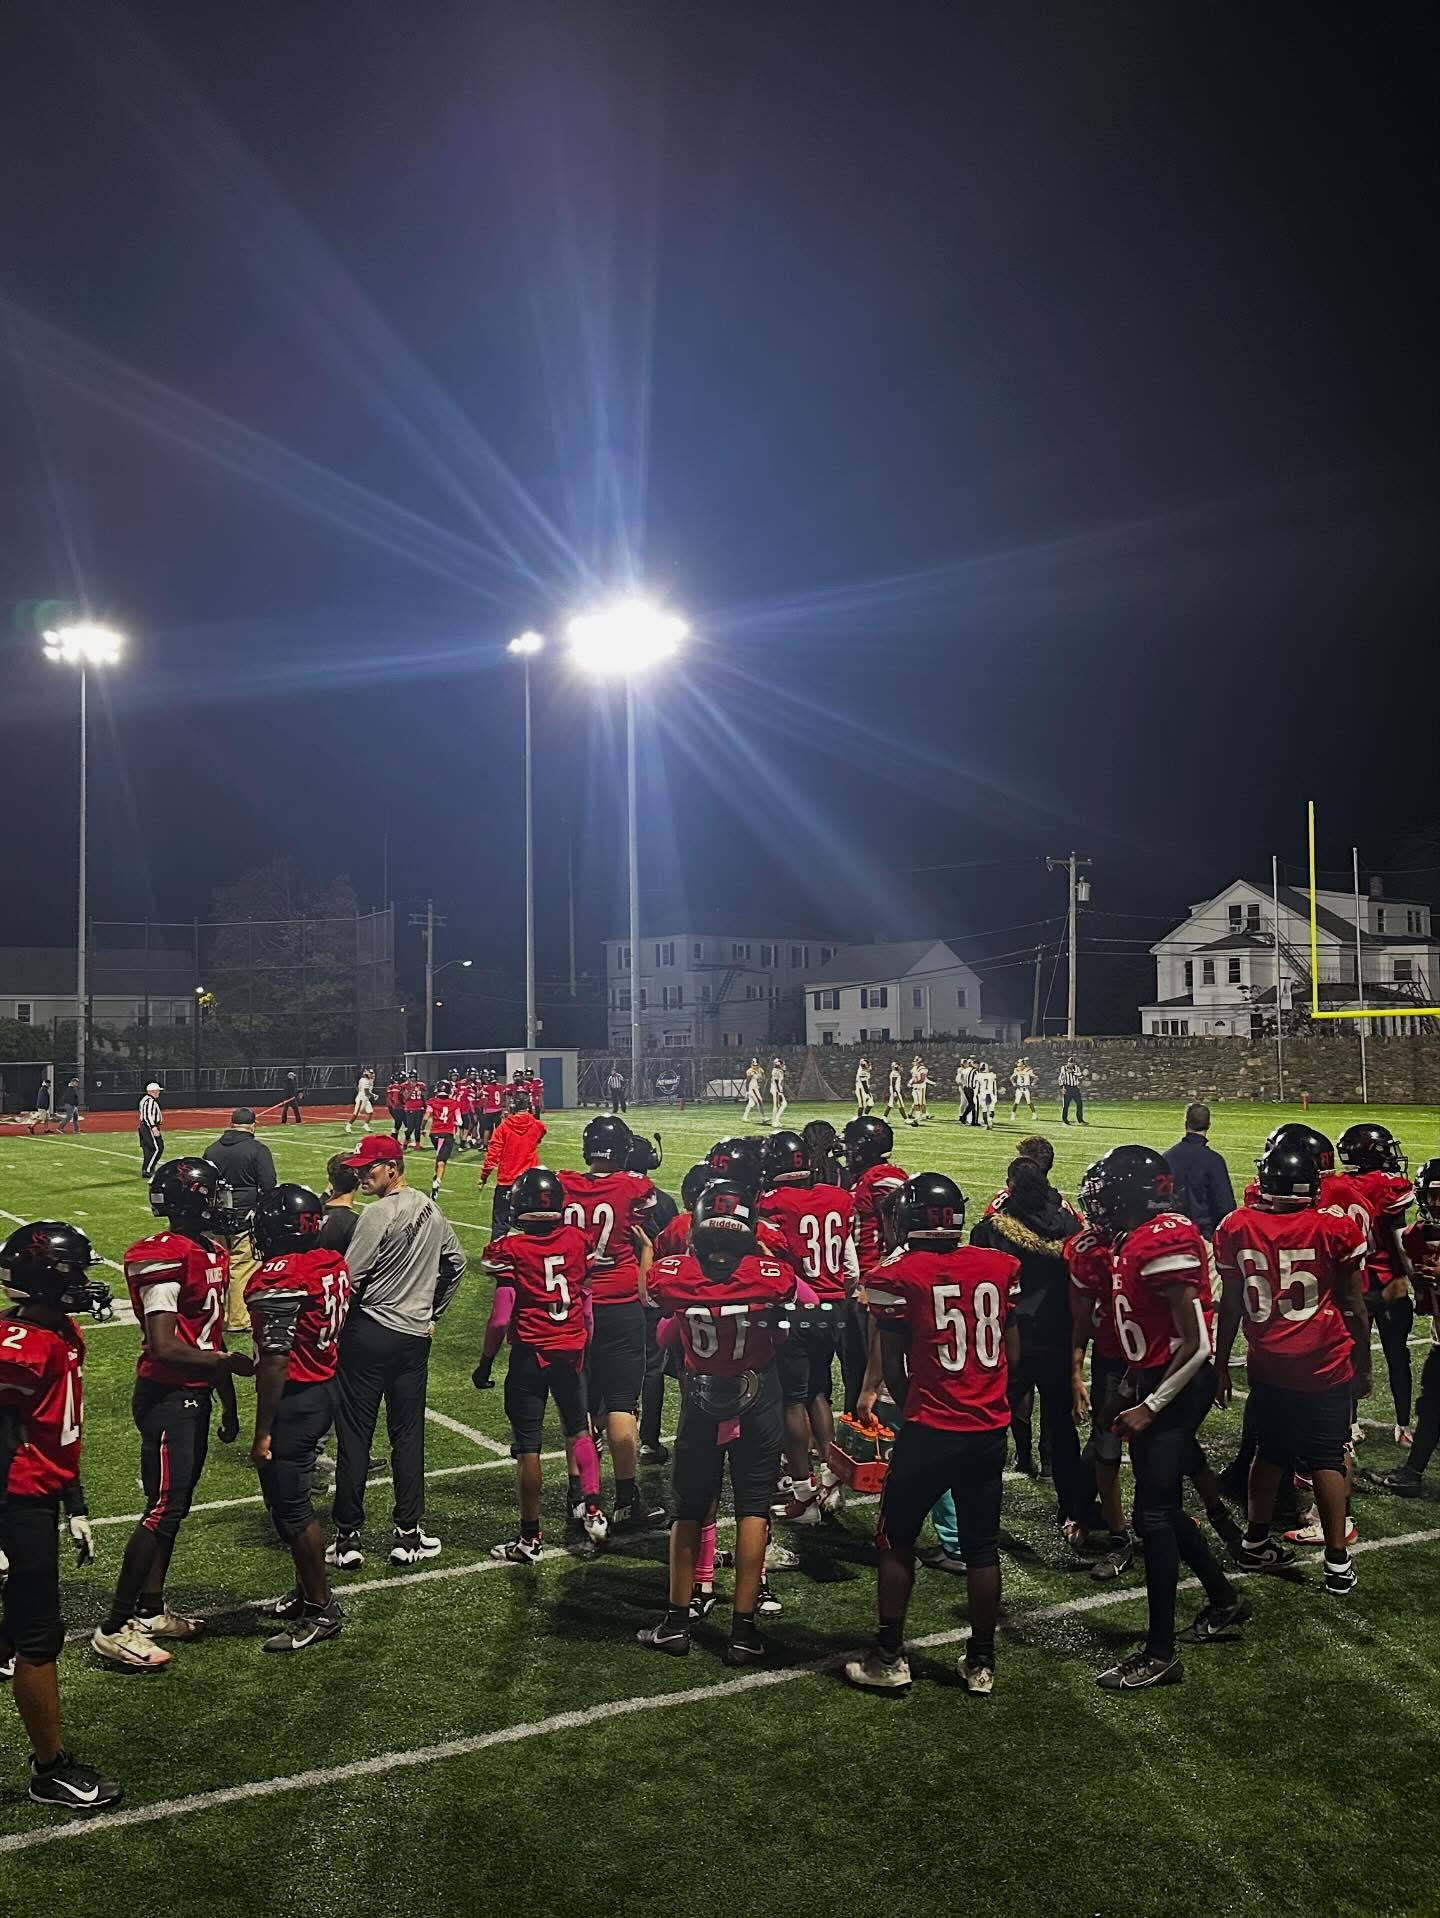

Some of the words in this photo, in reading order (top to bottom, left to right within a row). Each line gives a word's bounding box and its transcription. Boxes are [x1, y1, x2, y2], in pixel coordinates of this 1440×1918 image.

[440, 1106, 449, 1124] 4
[708, 1219, 743, 1231] Riddell
[713, 1194, 742, 1216] 67
[799, 1211, 843, 1278] 36
[543, 1255, 571, 1322] 5
[1236, 1248, 1320, 1323] 65
[0, 1325, 28, 1350] 2
[683, 1305, 751, 1361] 67
[932, 1282, 1002, 1372] 58
